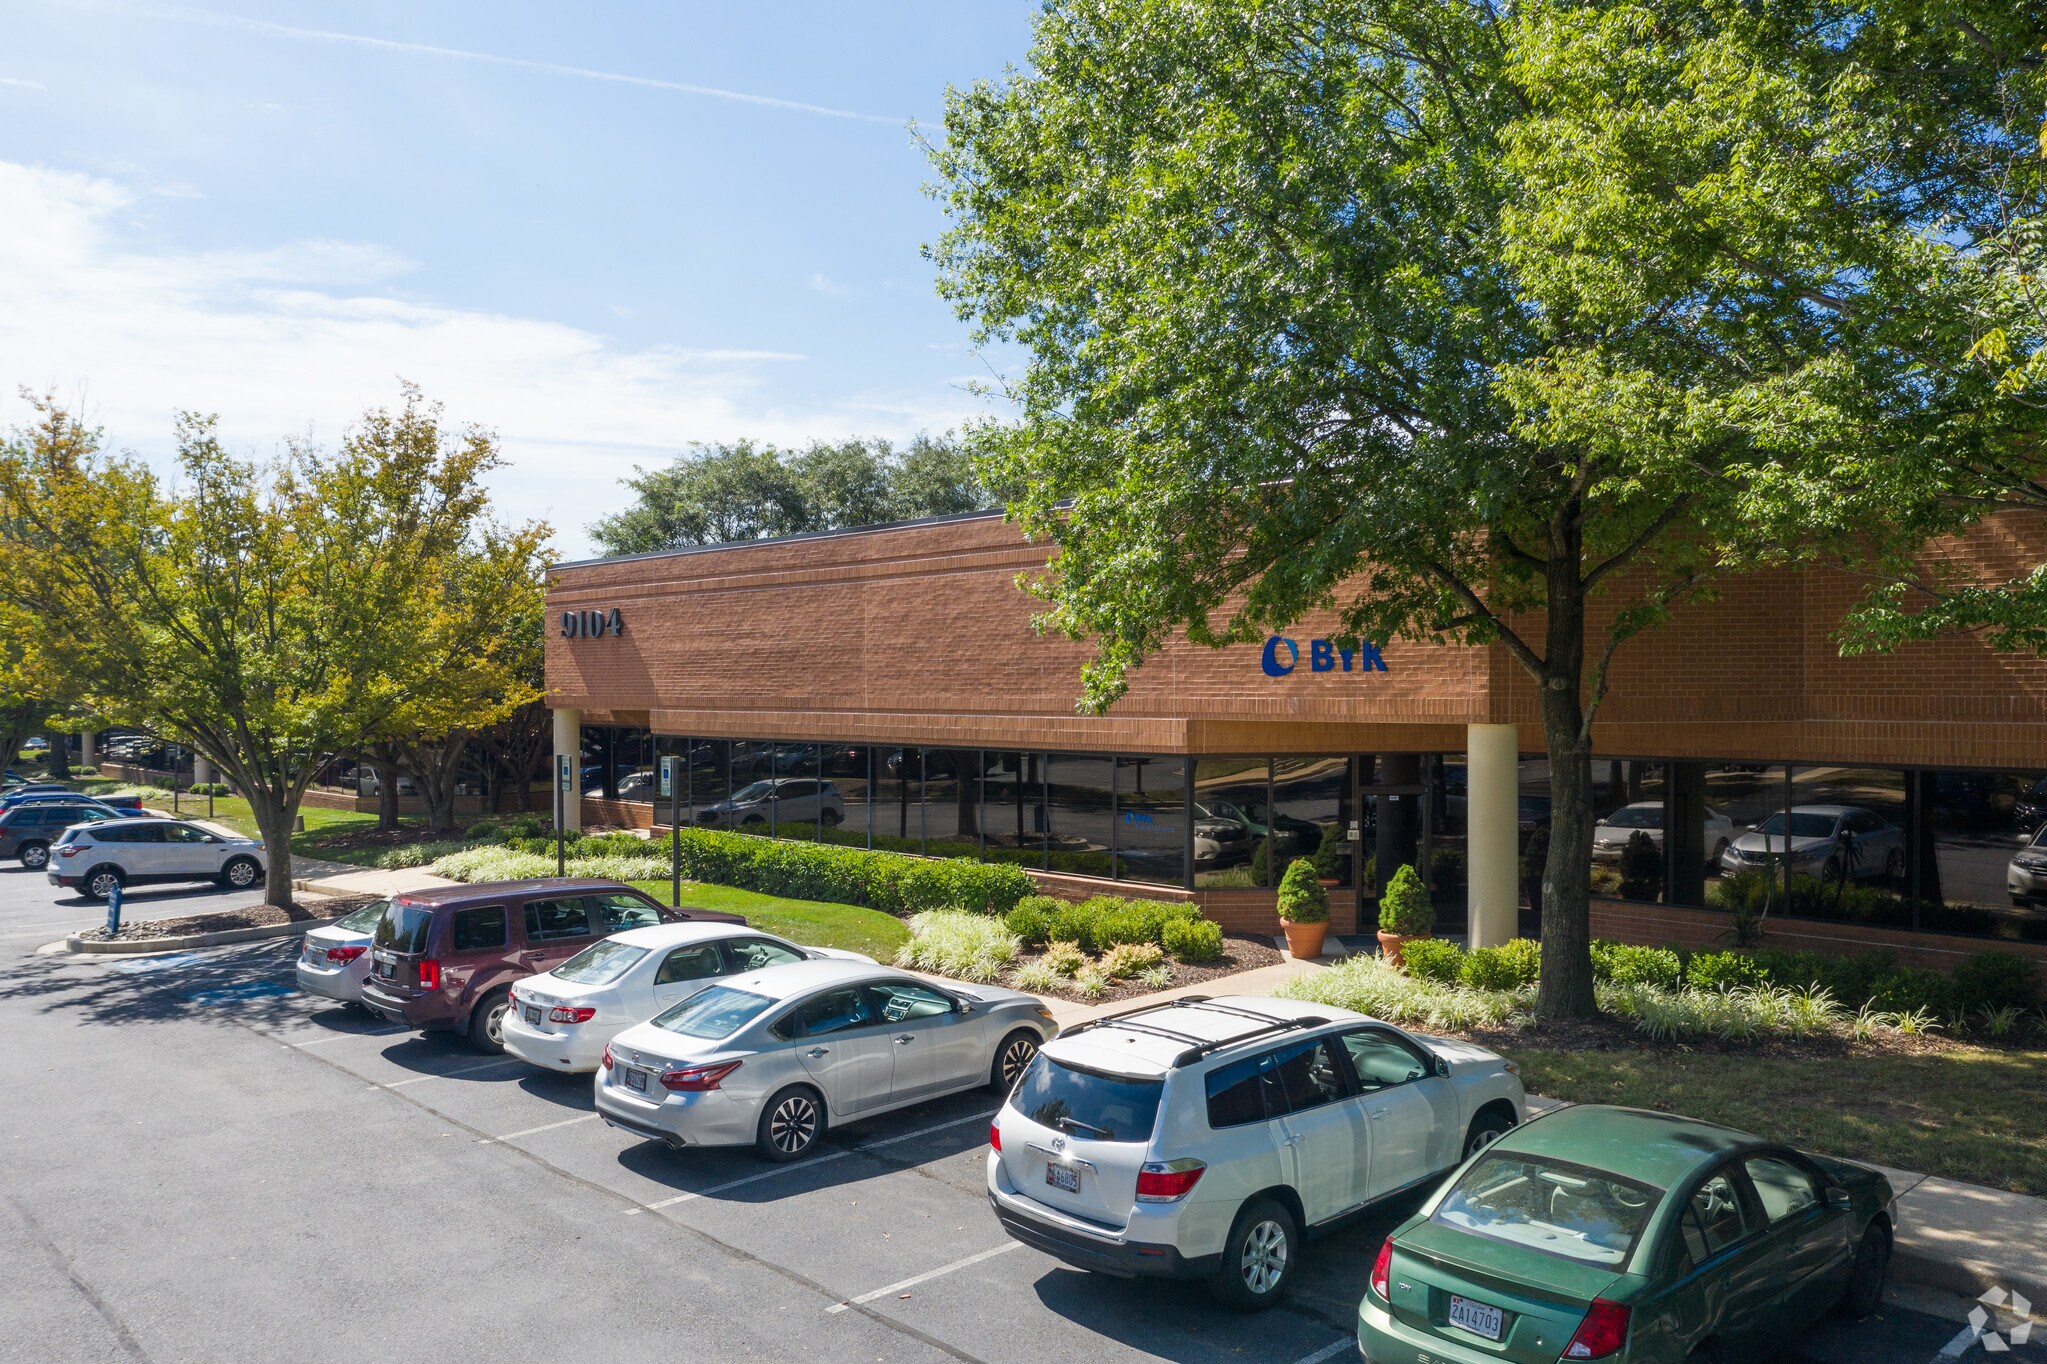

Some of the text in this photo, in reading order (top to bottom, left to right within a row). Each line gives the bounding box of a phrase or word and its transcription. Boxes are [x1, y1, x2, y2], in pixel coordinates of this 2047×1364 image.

[559, 608, 621, 639] 9104
[1311, 639, 1388, 672] BYK
[1451, 1304, 1499, 1332] 2A14703
